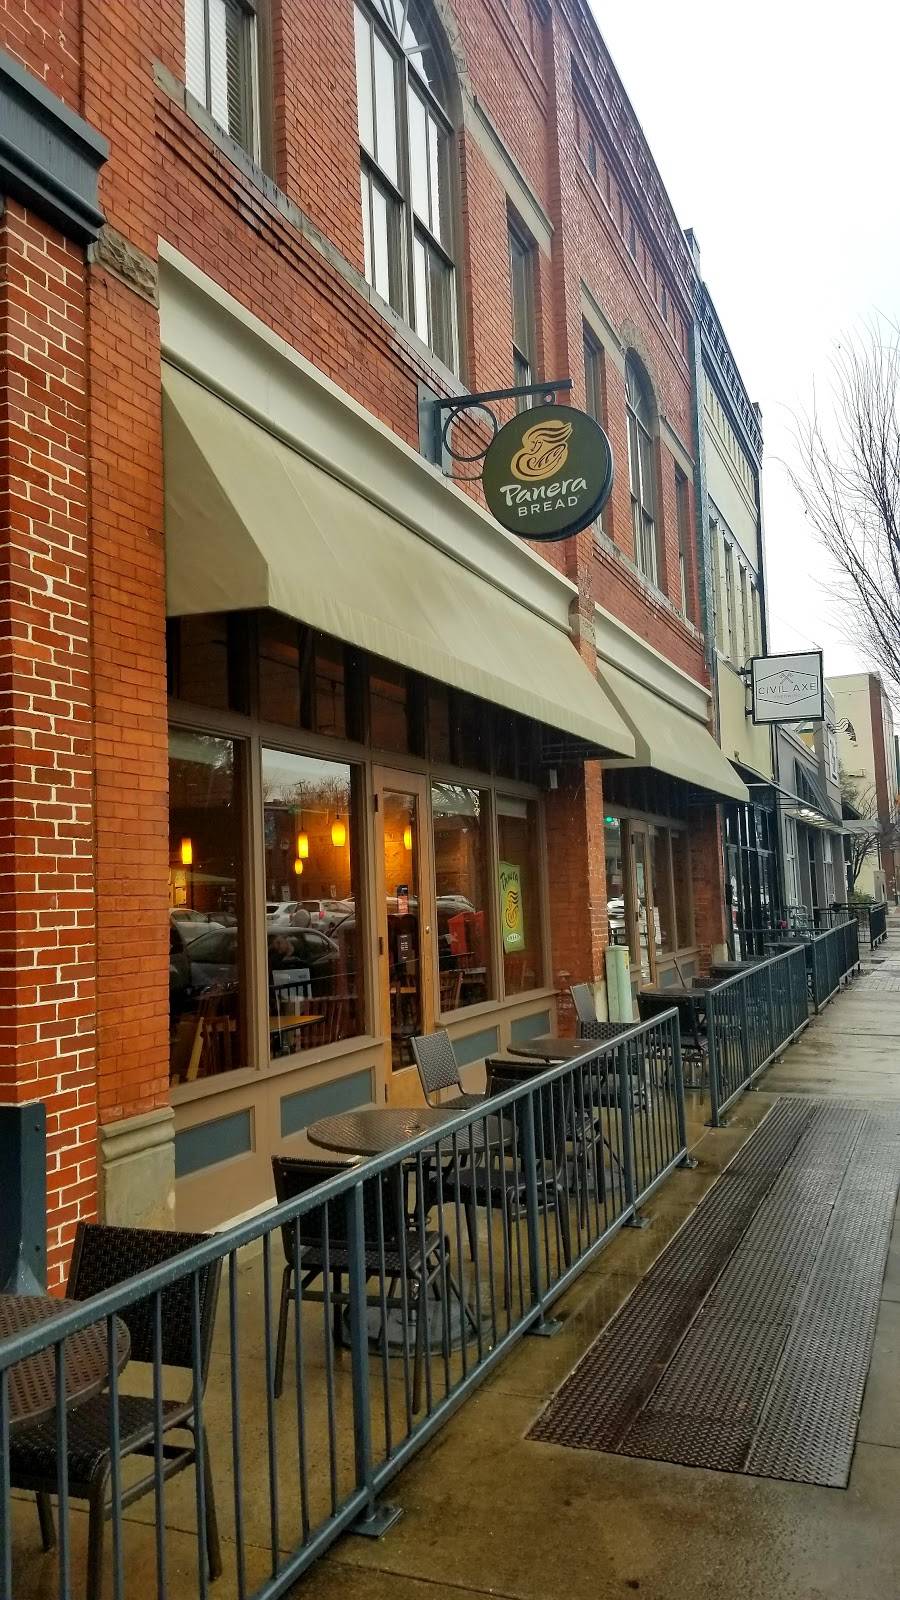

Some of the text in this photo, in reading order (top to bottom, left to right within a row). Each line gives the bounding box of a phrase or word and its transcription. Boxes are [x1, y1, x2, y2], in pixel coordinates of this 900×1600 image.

[500, 477, 588, 506] Panera
[518, 496, 578, 517] BREAD
[758, 682, 817, 695] CIVIL AXE
